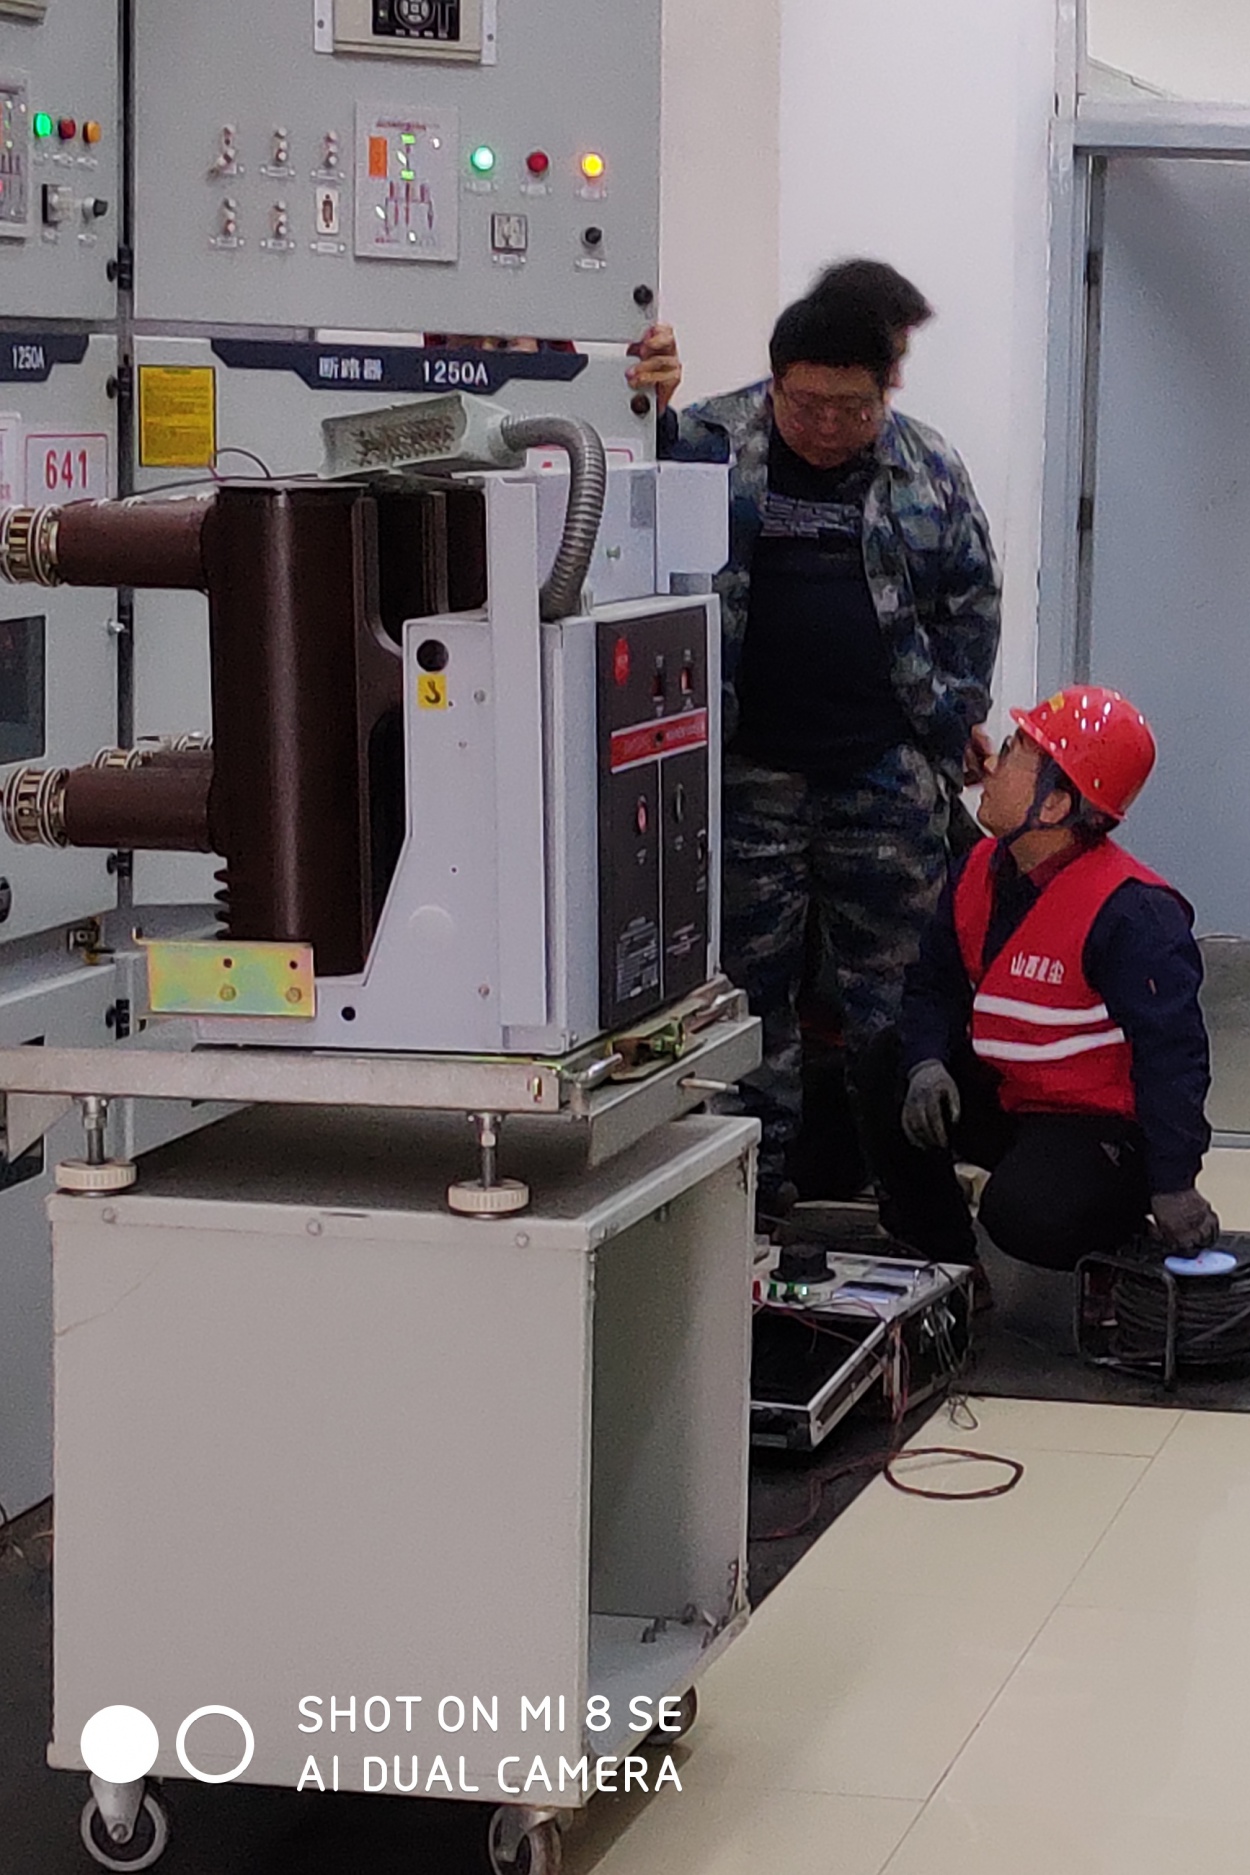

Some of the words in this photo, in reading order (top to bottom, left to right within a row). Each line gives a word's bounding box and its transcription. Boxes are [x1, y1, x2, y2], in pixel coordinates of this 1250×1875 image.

[11, 345, 45, 369] 1250A
[318, 356, 383, 381] 断路器
[422, 359, 489, 386] 1250A
[45, 450, 87, 489] 641
